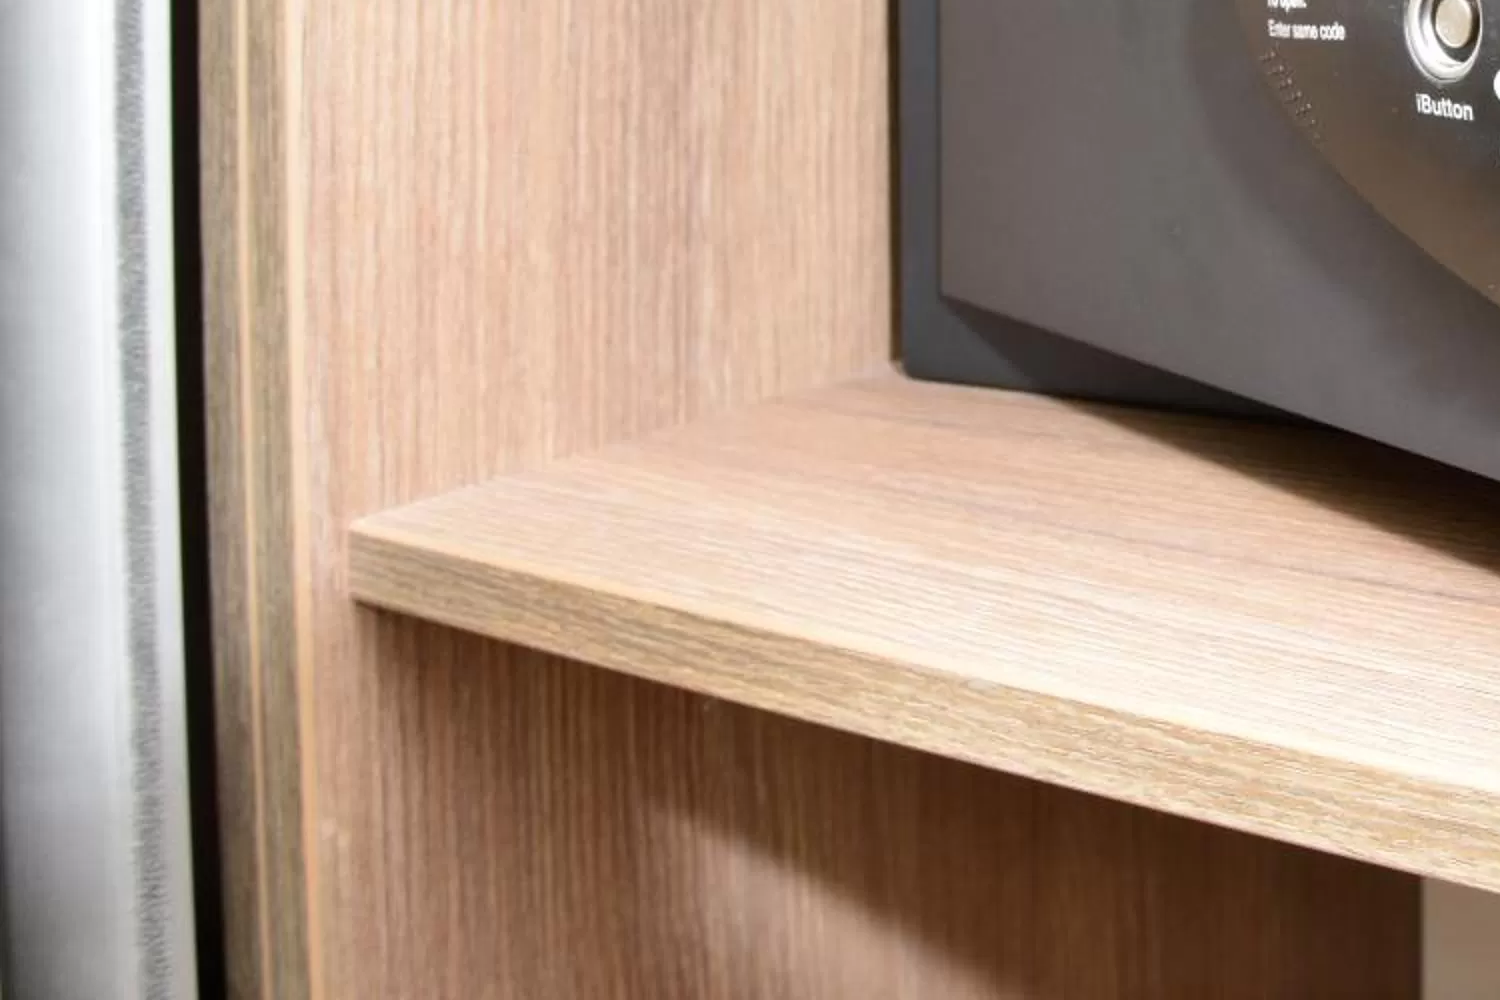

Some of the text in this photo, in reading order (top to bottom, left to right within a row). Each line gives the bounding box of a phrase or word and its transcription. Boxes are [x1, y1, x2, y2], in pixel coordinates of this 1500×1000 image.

[1267, 18, 1346, 41] Enter same code
[1415, 93, 1474, 121] iButton
